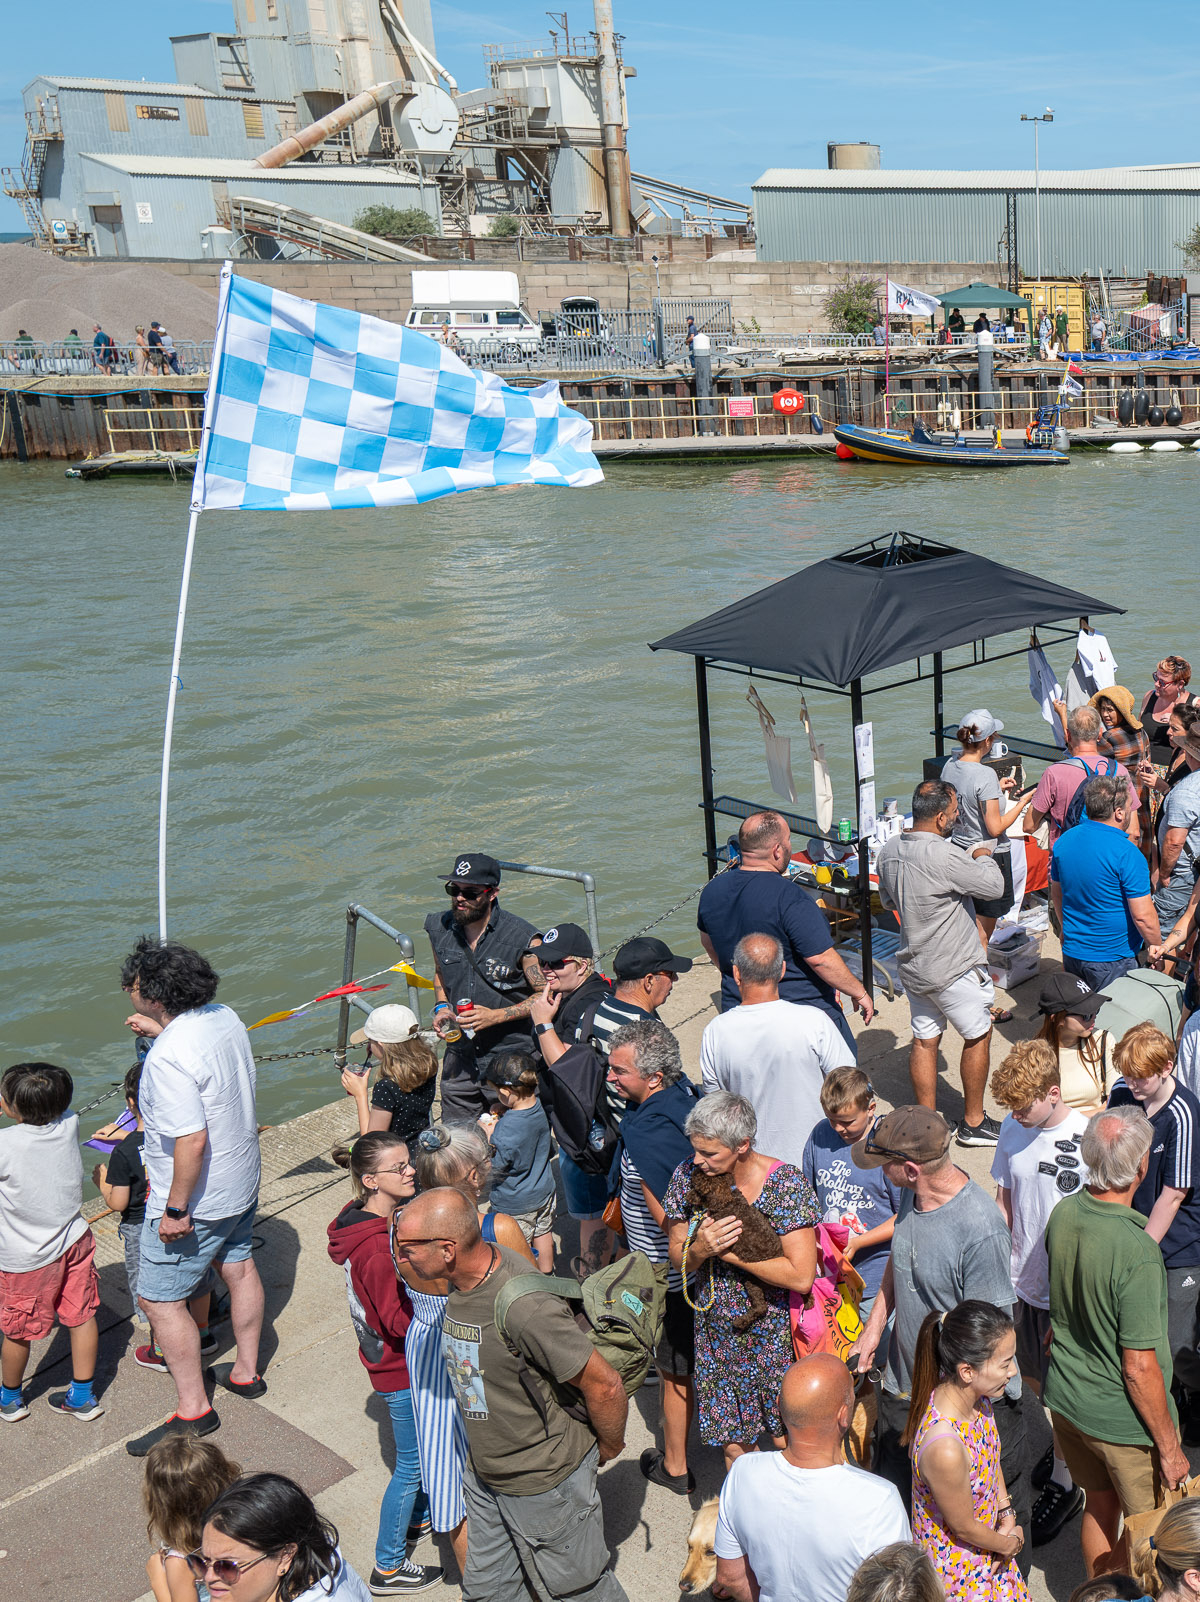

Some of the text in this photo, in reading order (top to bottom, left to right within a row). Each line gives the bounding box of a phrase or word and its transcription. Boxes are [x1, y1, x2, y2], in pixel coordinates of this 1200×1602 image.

[896, 290, 914, 306] RYA
[829, 1160, 852, 1177] The
[816, 1169, 864, 1200] Rolling
